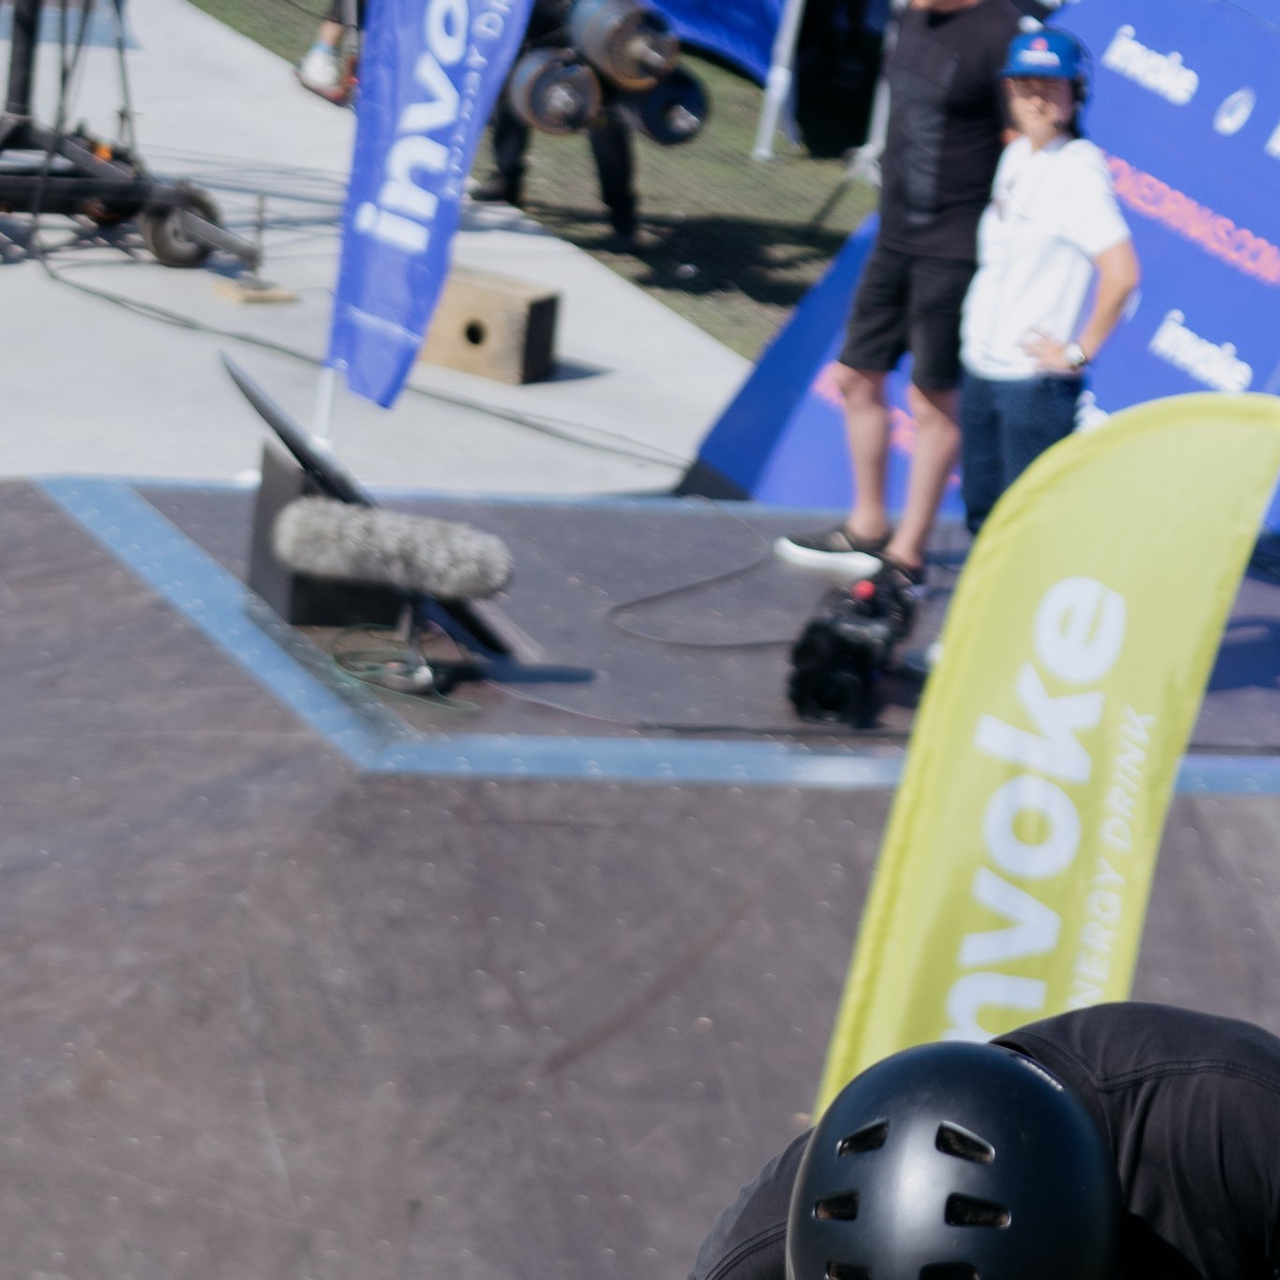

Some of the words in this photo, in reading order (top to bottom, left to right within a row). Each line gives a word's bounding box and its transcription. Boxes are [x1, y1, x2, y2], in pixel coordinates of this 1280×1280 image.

[353, 0, 470, 253] invo
[1103, 24, 1199, 105] invoke
[941, 575, 1127, 1042] nvoke
[1065, 857, 1128, 1013] NERGY
[1099, 703, 1157, 853] DRINK
